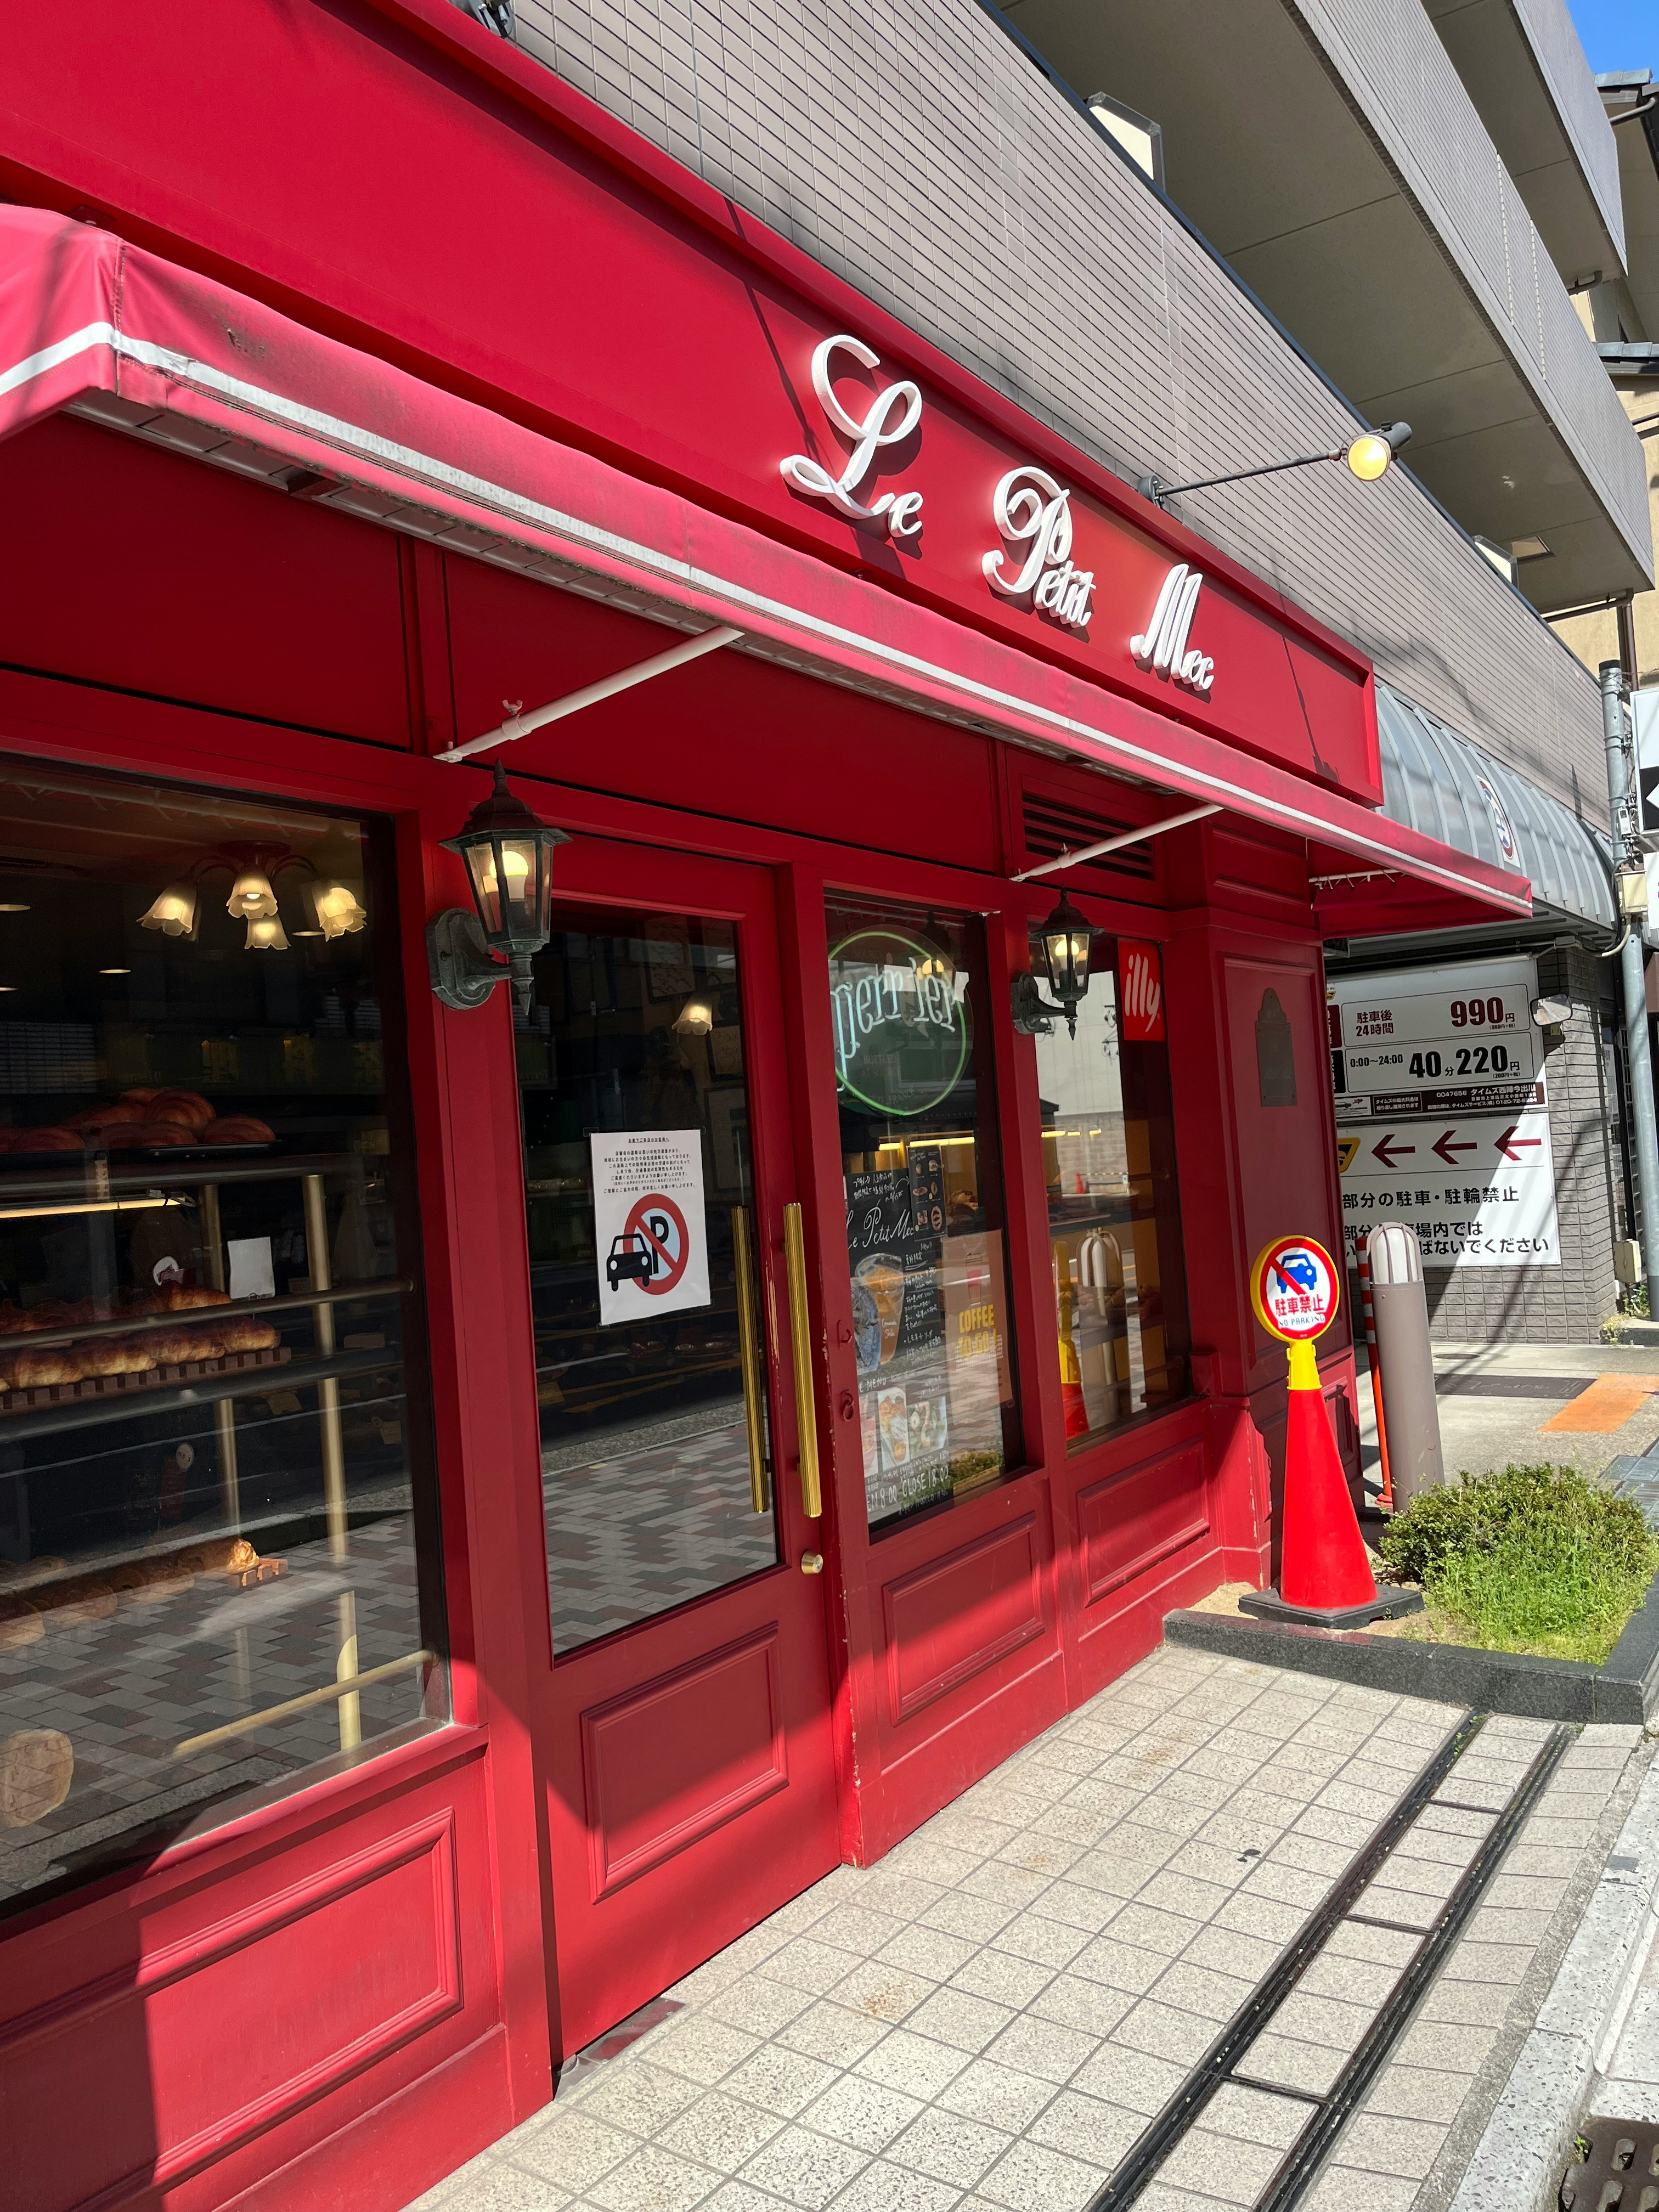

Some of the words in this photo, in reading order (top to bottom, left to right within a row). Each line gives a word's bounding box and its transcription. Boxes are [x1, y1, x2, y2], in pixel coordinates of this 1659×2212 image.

[779, 334, 923, 538] Le
[981, 466, 1097, 629] Petit
[1130, 563, 1215, 692] Mec
[1124, 952, 1161, 1032] illy
[1357, 1009, 1392, 1024] 駐車後
[1356, 1023, 1394, 1036] 24時間
[1274, 1294, 1325, 1317] 駐車禁止
[959, 1304, 995, 1334] COFFEE
[1278, 1319, 1288, 1327] NO
[1291, 1315, 1325, 1326] PARKING
[902, 1472, 927, 1498] CLOSE
